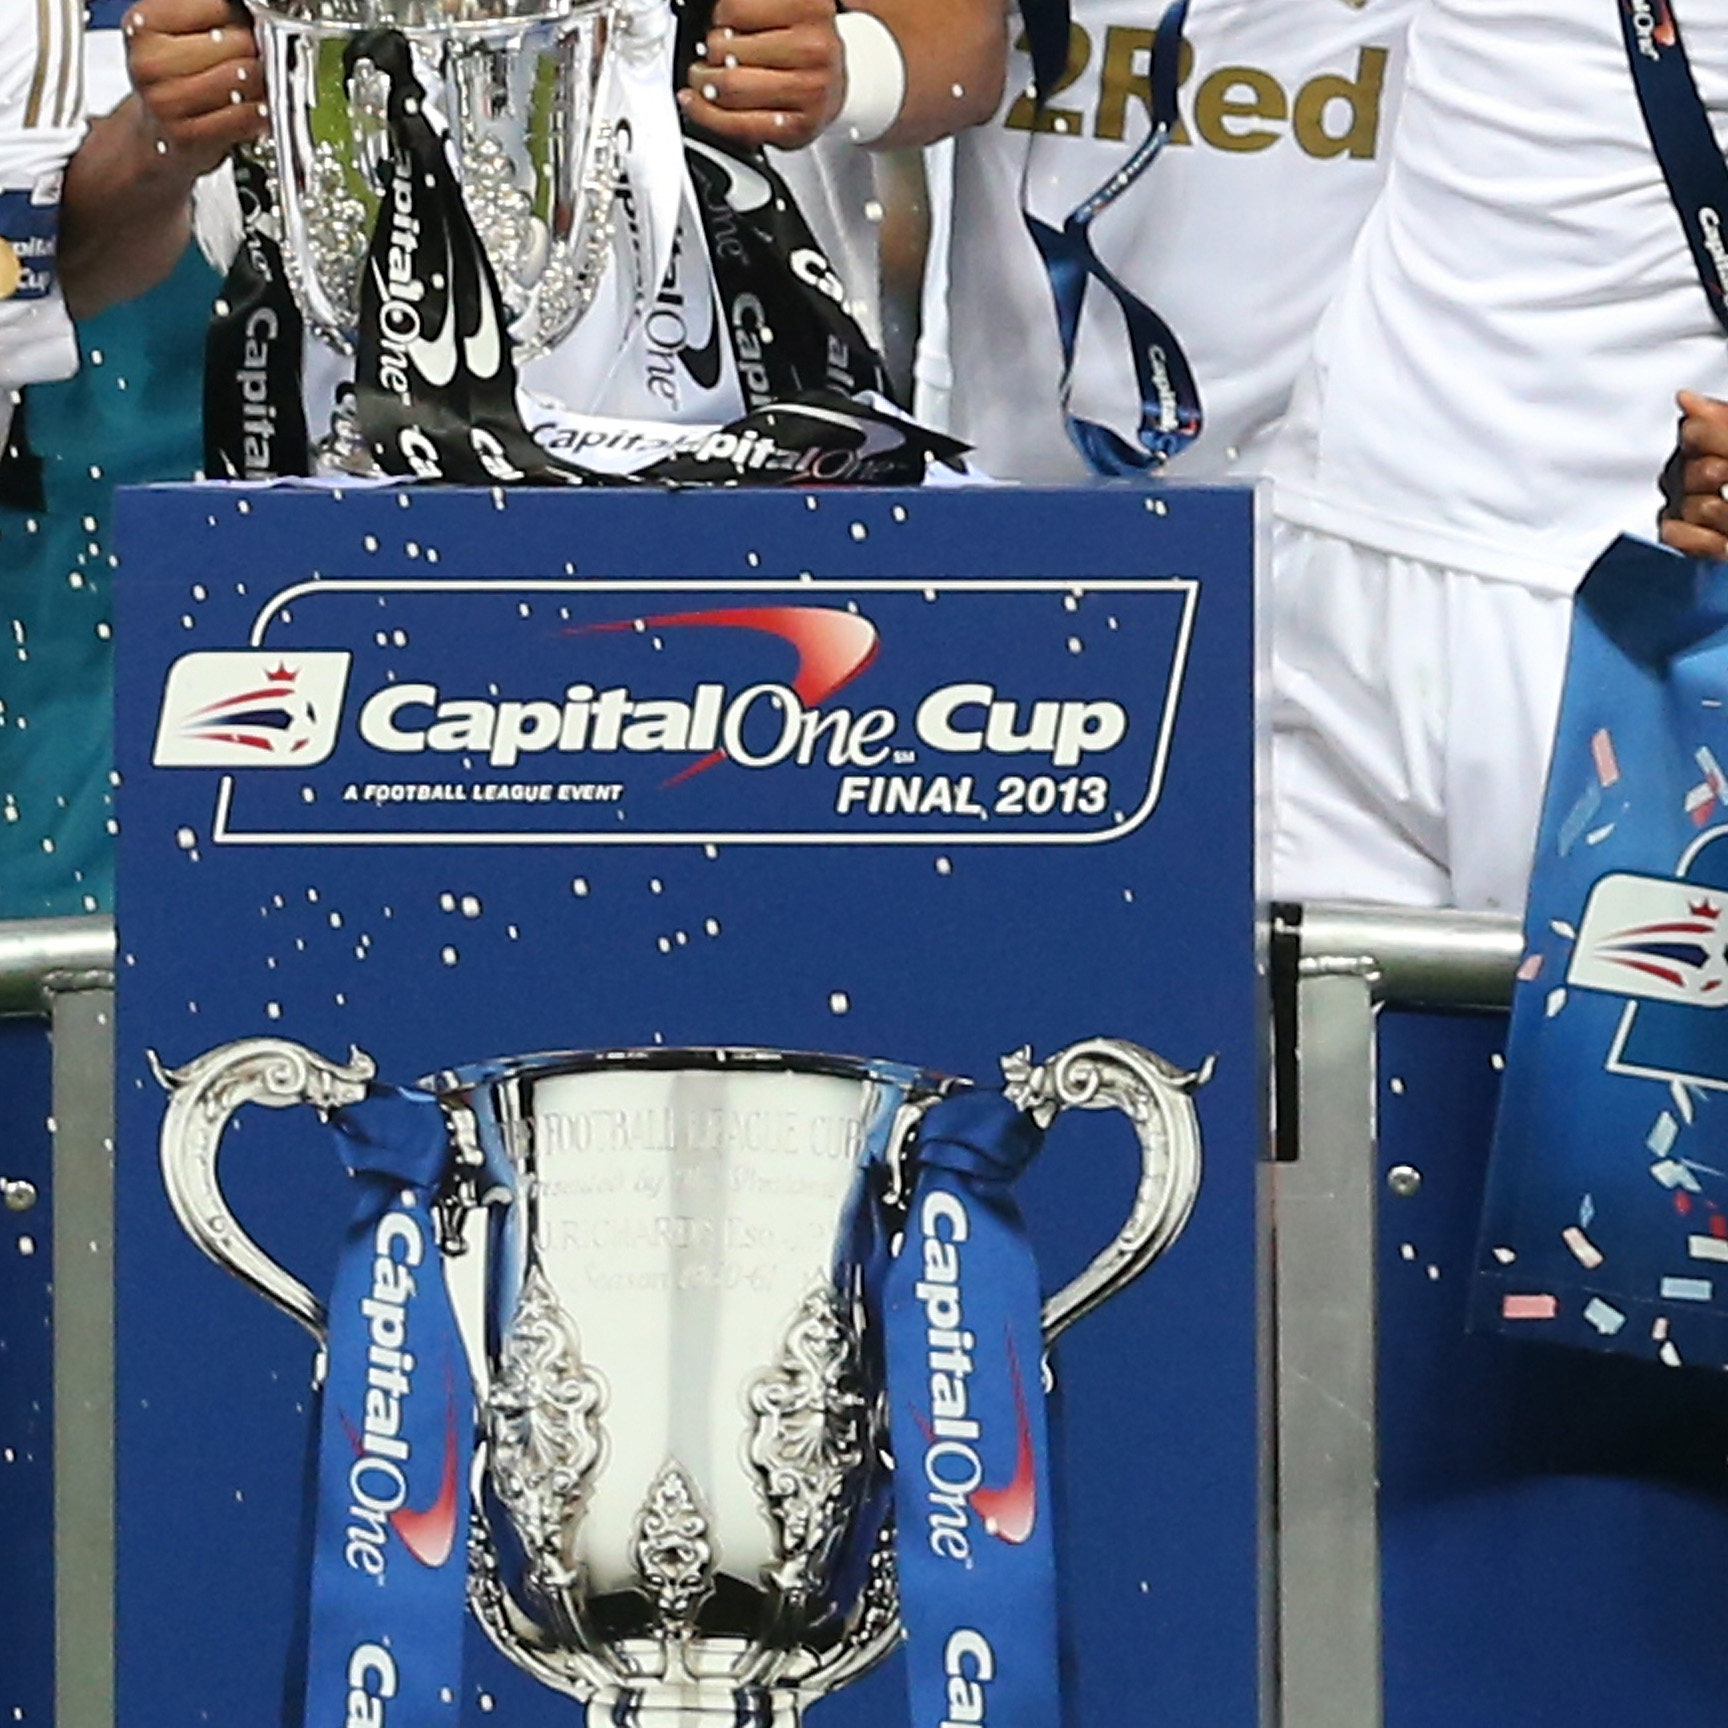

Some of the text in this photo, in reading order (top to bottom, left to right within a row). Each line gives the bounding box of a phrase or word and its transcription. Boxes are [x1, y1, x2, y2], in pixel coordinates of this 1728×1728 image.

[1004, 22, 1389, 161] 2Red
[360, 683, 899, 768] CapitalOne
[914, 683, 1127, 767] Cup
[343, 783, 623, 801] A FOOTBALL LEAGUE EVENT
[836, 775, 1108, 815] FINAL 2013
[345, 1210, 425, 1578] CapitalOne
[919, 1189, 984, 1562] CapitalOne
